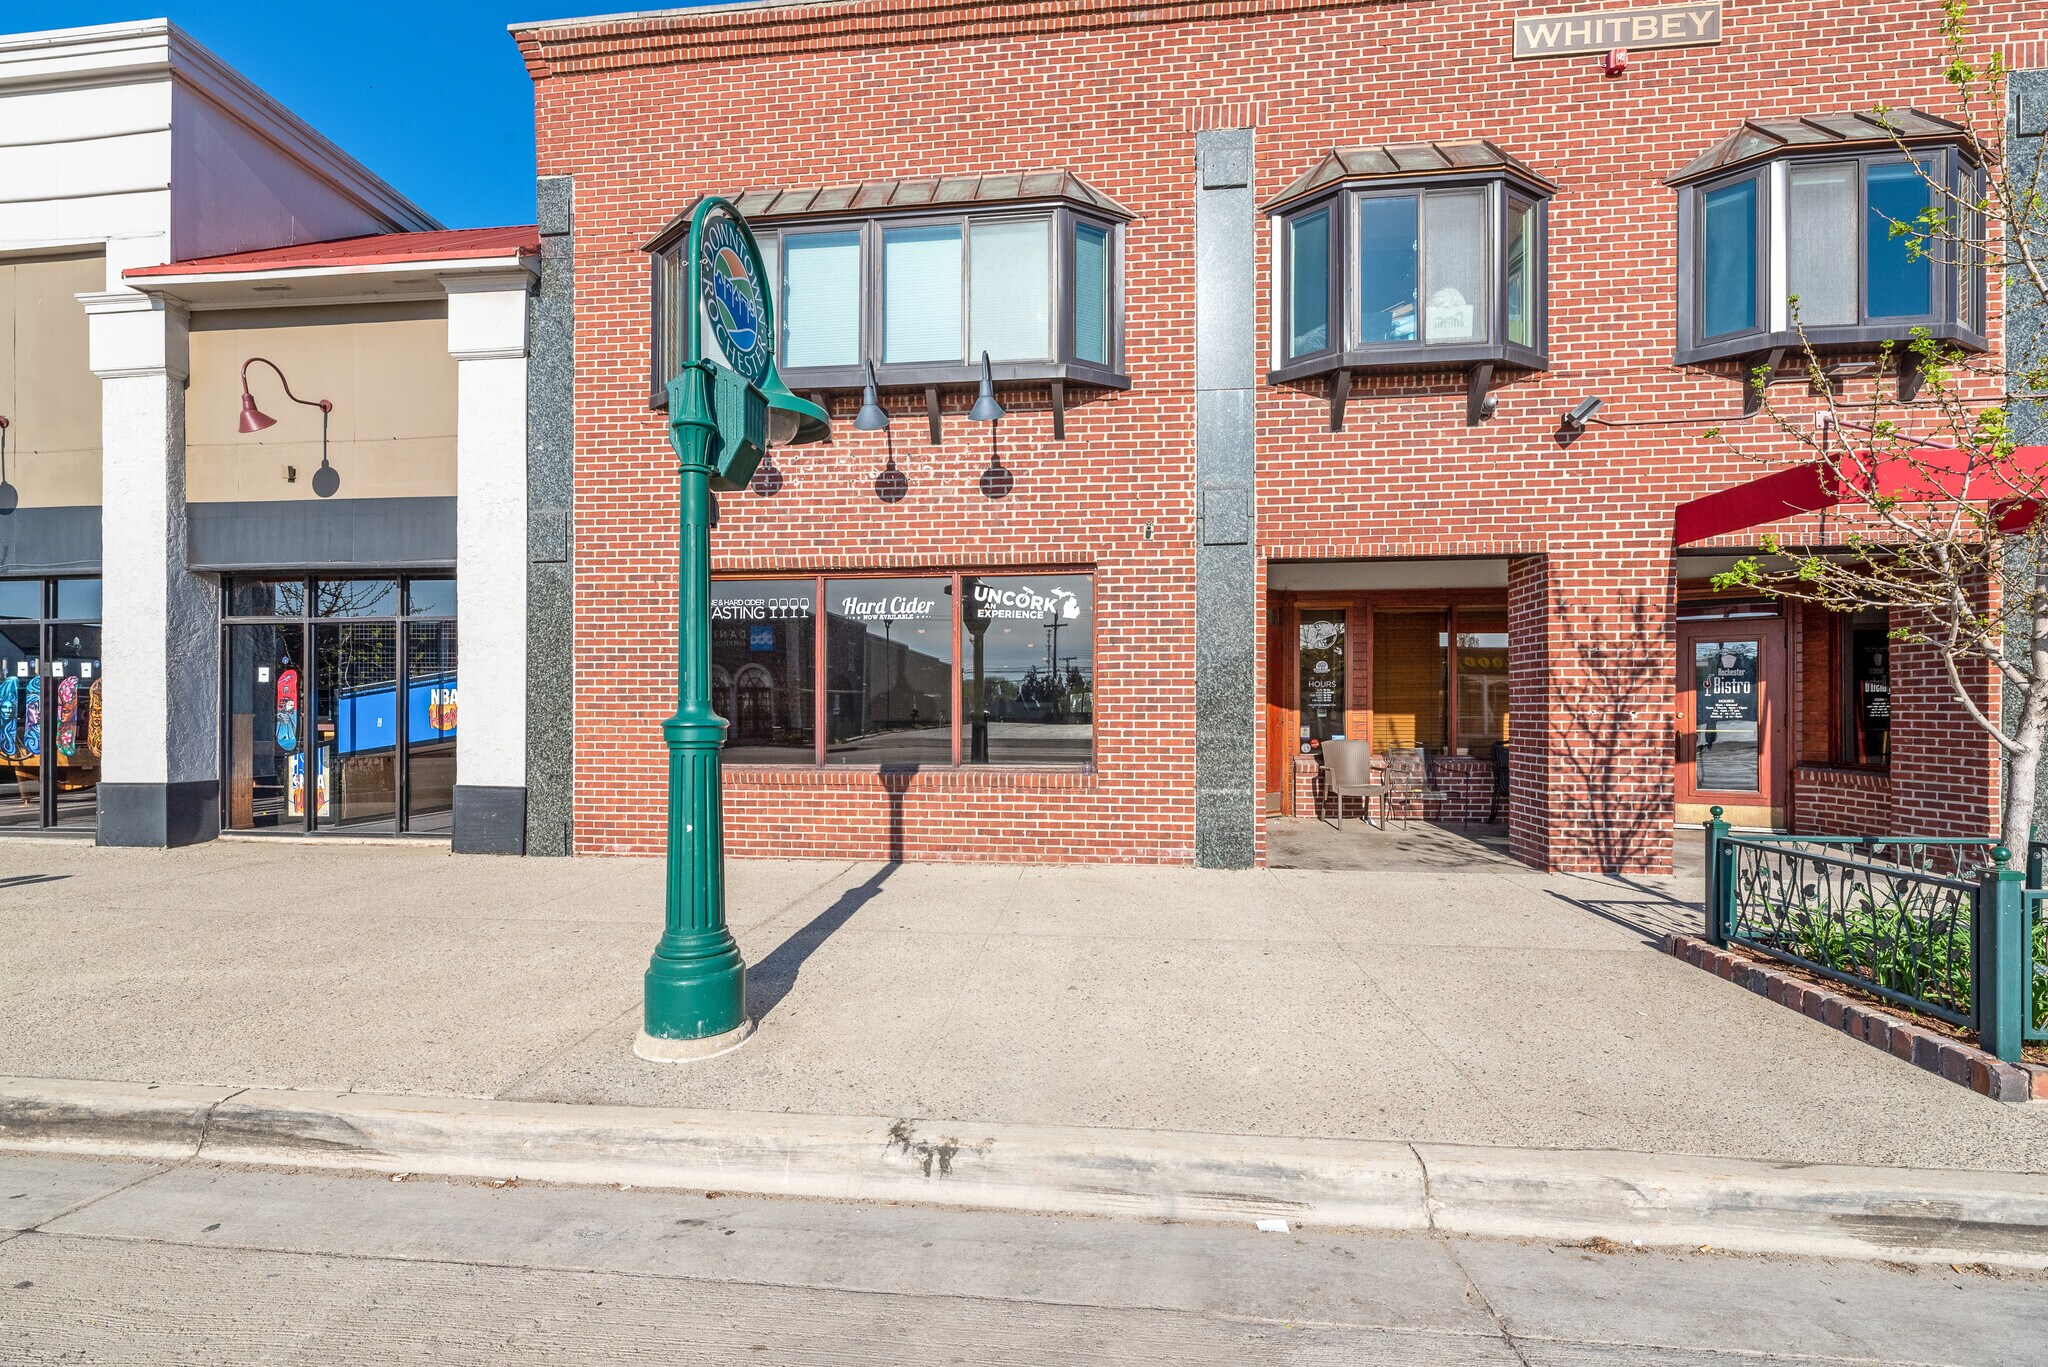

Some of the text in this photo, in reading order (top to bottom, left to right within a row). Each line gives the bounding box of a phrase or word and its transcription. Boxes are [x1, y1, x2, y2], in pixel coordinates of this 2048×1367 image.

[1521, 10, 1716, 49] WHITBEY
[703, 222, 767, 327] DOWNTOWN
[703, 278, 768, 377] ROCHESTER
[842, 596, 935, 615] Hard Cider
[974, 585, 1058, 614] UNCORK
[983, 602, 997, 610] AN
[711, 606, 765, 620] ASTING
[977, 609, 1044, 620] EXPERIENCE
[1718, 668, 1746, 676] Rochester
[1308, 680, 1337, 688] HOURS
[1713, 676, 1751, 694] Bistro
[430, 688, 458, 705] NBA
